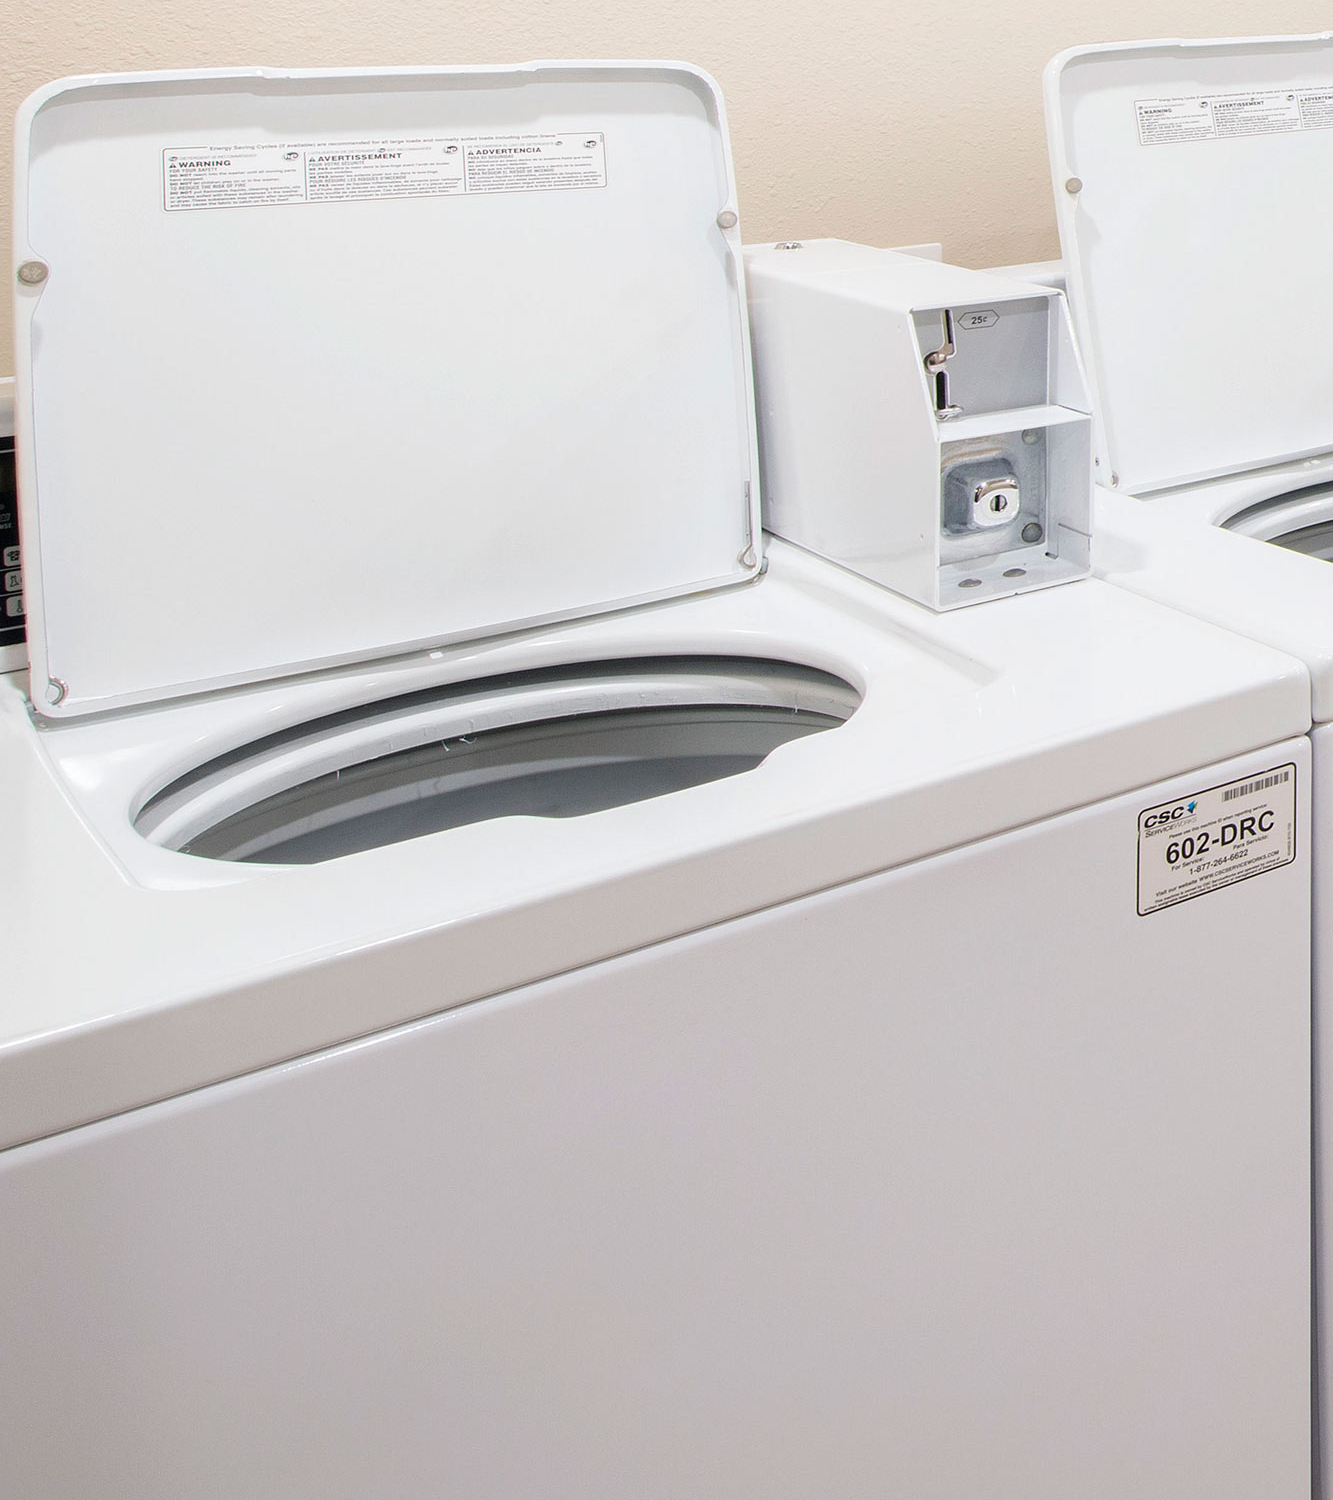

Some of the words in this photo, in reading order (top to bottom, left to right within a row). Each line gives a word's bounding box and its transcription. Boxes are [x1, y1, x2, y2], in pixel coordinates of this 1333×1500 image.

[475, 147, 541, 155] ADVERTENCIA
[317, 152, 401, 162] AVERTISSEMENT
[178, 159, 231, 168] WARNING
[1144, 806, 1184, 828] CSC
[1166, 810, 1275, 864] 602-DRC
[1233, 842, 1245, 850] Para
[1189, 849, 1248, 875] 1-877-264-6622
